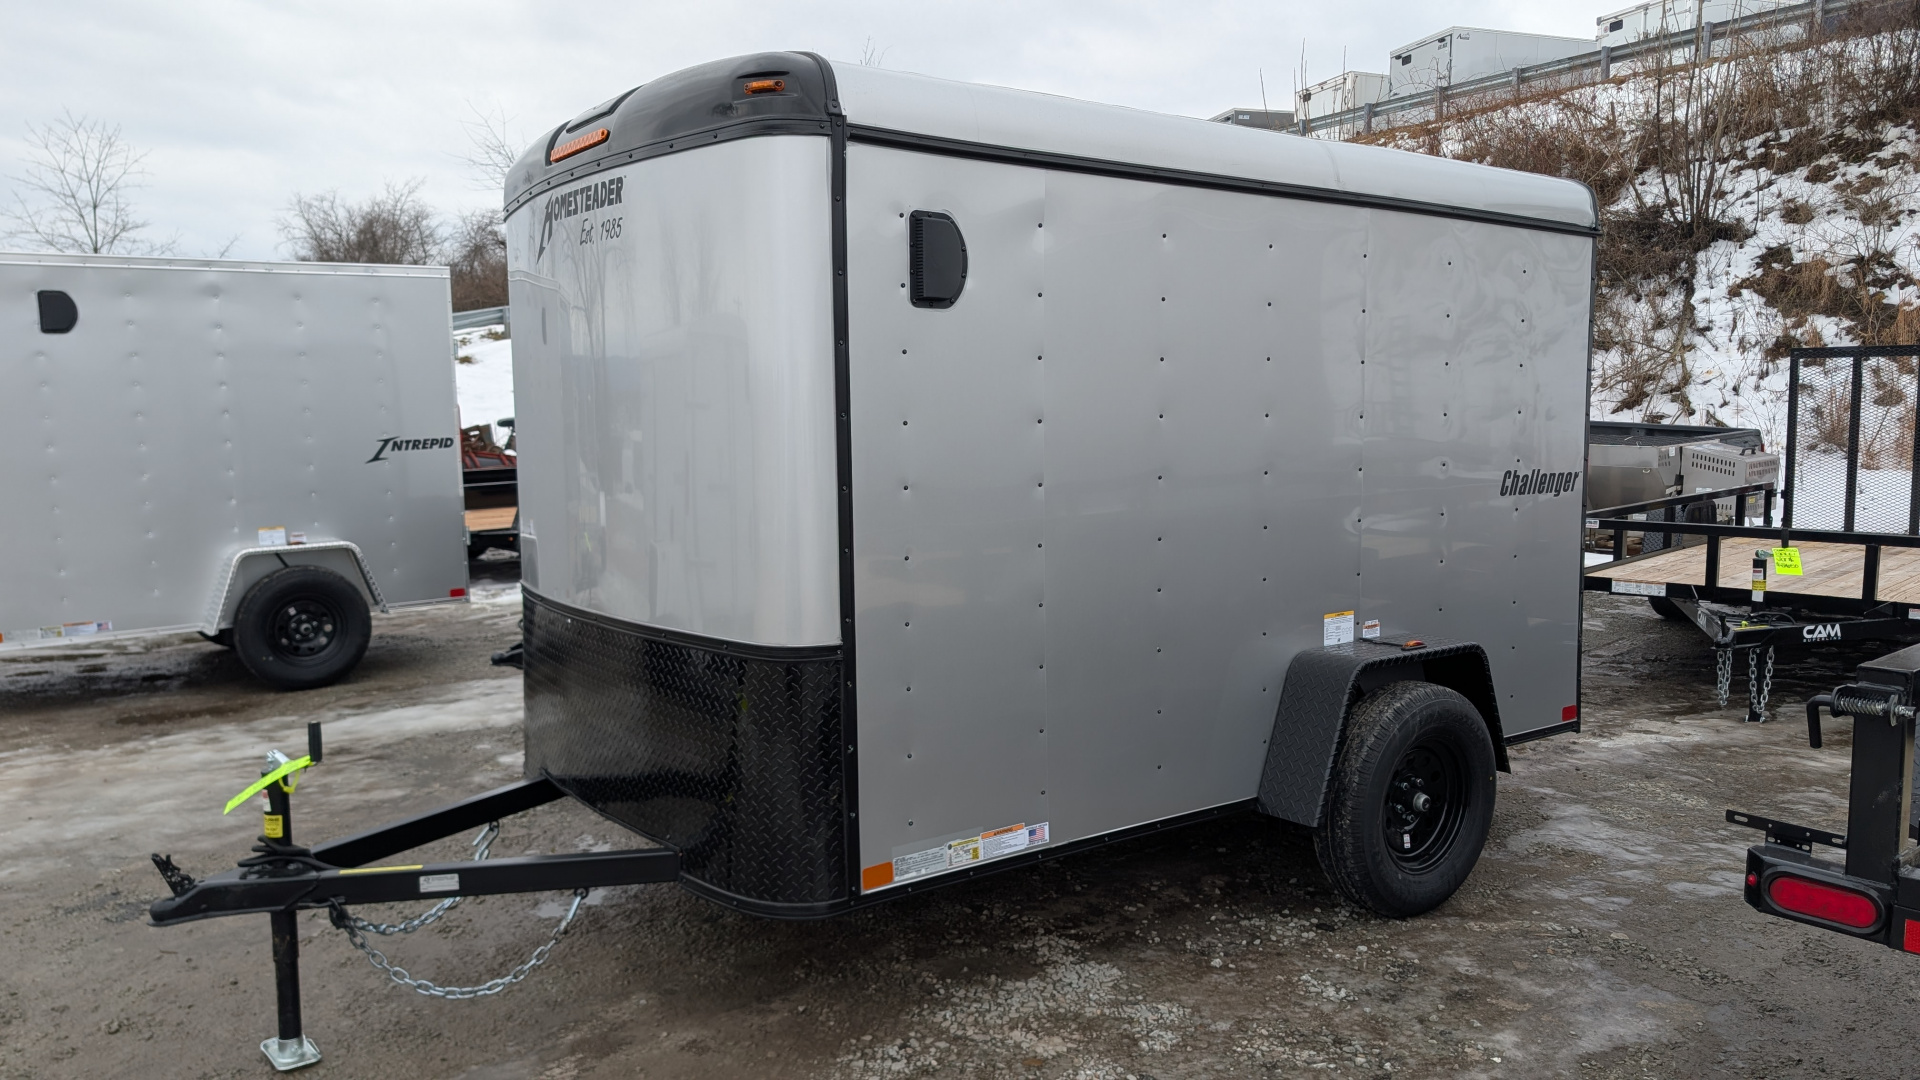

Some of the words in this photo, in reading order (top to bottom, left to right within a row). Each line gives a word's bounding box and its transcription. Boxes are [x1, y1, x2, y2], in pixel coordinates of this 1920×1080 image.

[536, 176, 624, 265] HOMESTEADER
[600, 216, 624, 241] 1985
[365, 436, 455, 464] INTREPID
[1499, 468, 1580, 497] Challenger
[1802, 623, 1841, 639] CAM
